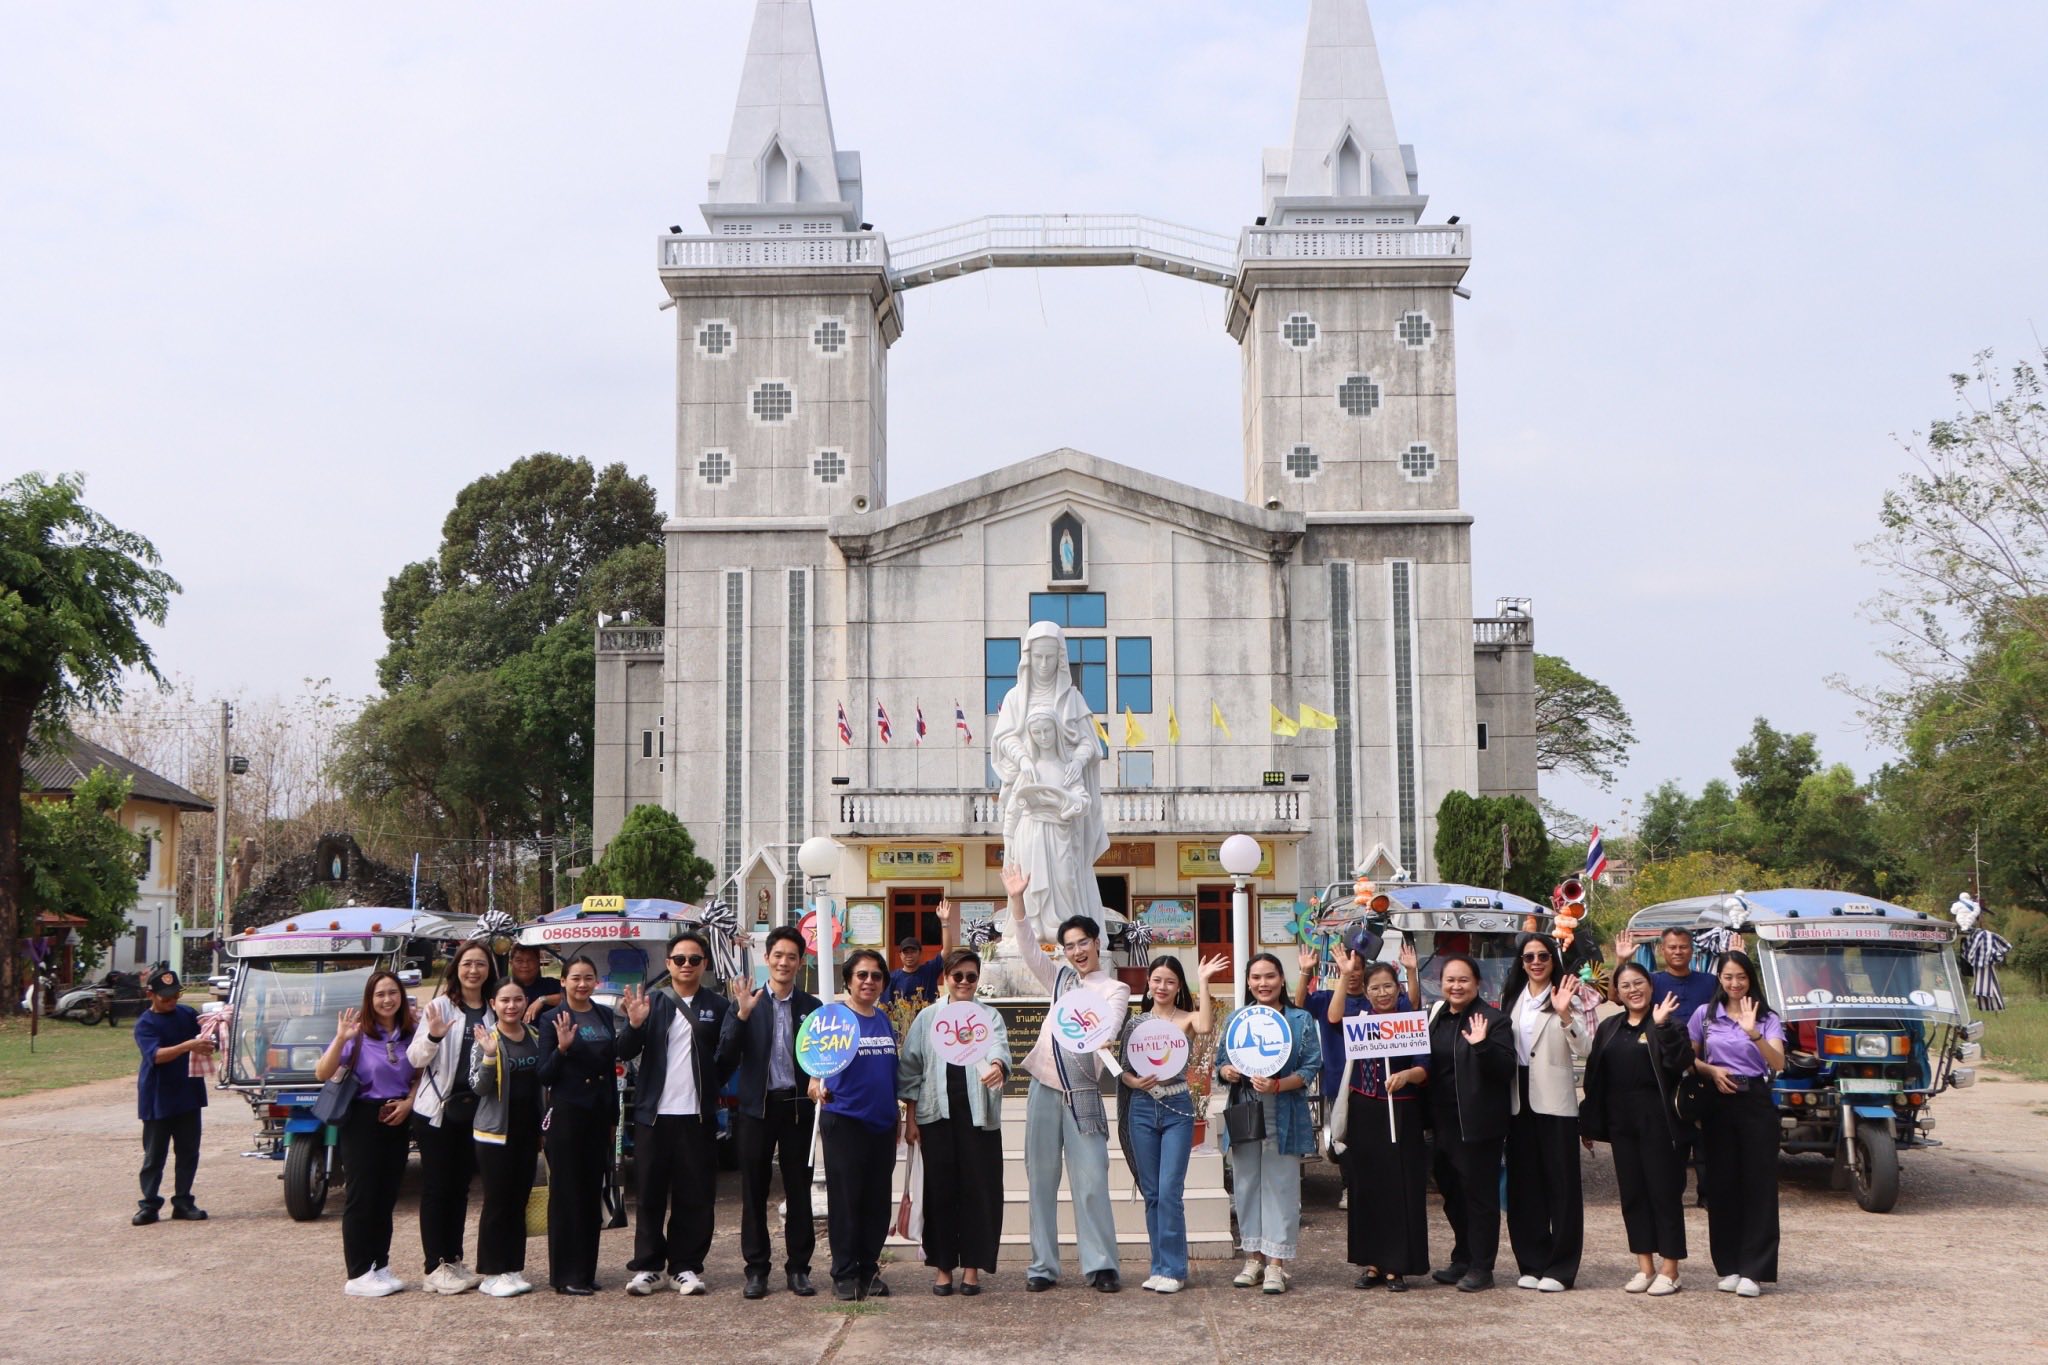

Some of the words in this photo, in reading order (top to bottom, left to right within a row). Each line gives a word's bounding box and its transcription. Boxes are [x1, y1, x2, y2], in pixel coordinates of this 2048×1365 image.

[590, 898, 617, 908] TAXI
[809, 1015, 842, 1034] ALL
[936, 1014, 988, 1046] 365
[1380, 1018, 1426, 1040] SMILE
[800, 1032, 855, 1053] E-SAN
[1144, 1033, 1170, 1041] amazing
[1130, 1039, 1186, 1053] THAILAND
[1349, 1043, 1368, 1052] บริษัท
[1409, 1039, 1428, 1047] จำกัด
